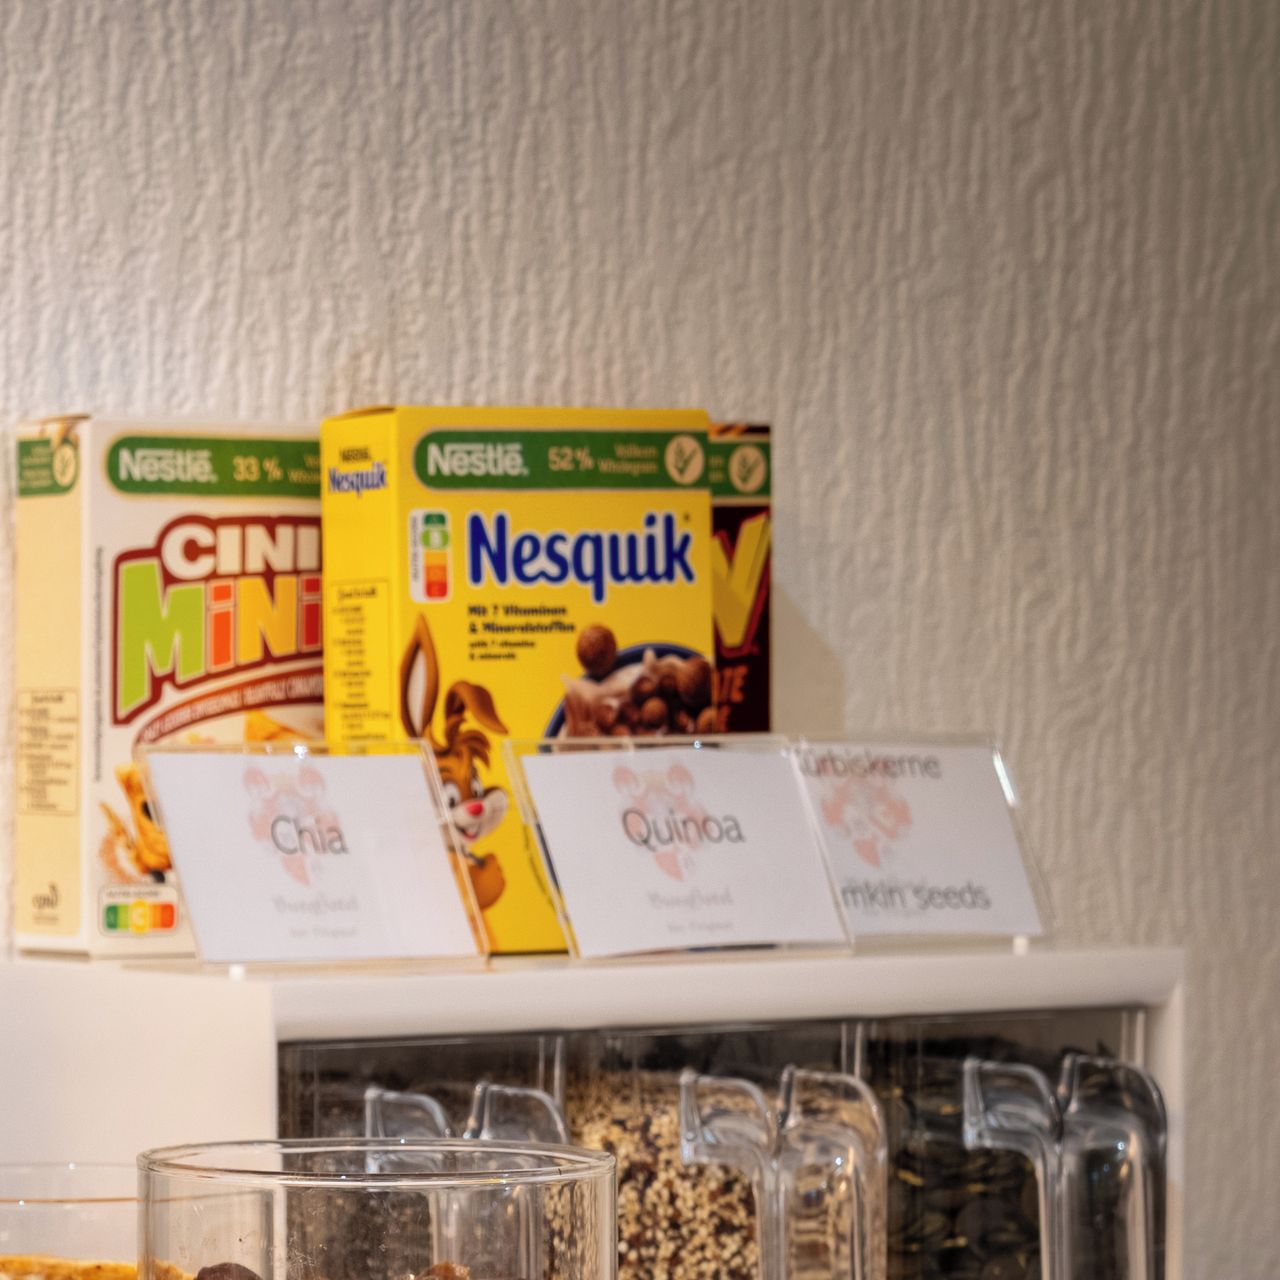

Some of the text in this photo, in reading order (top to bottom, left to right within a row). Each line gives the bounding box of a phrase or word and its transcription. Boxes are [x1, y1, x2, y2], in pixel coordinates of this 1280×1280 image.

[233, 455, 260, 482] 33
[262, 455, 283, 482] %
[548, 446, 574, 471] 52
[160, 522, 320, 580] CINI
[468, 514, 695, 603] Nesquik
[801, 747, 942, 779] ürbiskerne
[271, 814, 350, 855] Chia
[621, 807, 747, 852] Quinoa
[841, 880, 992, 911] mkin seeds
